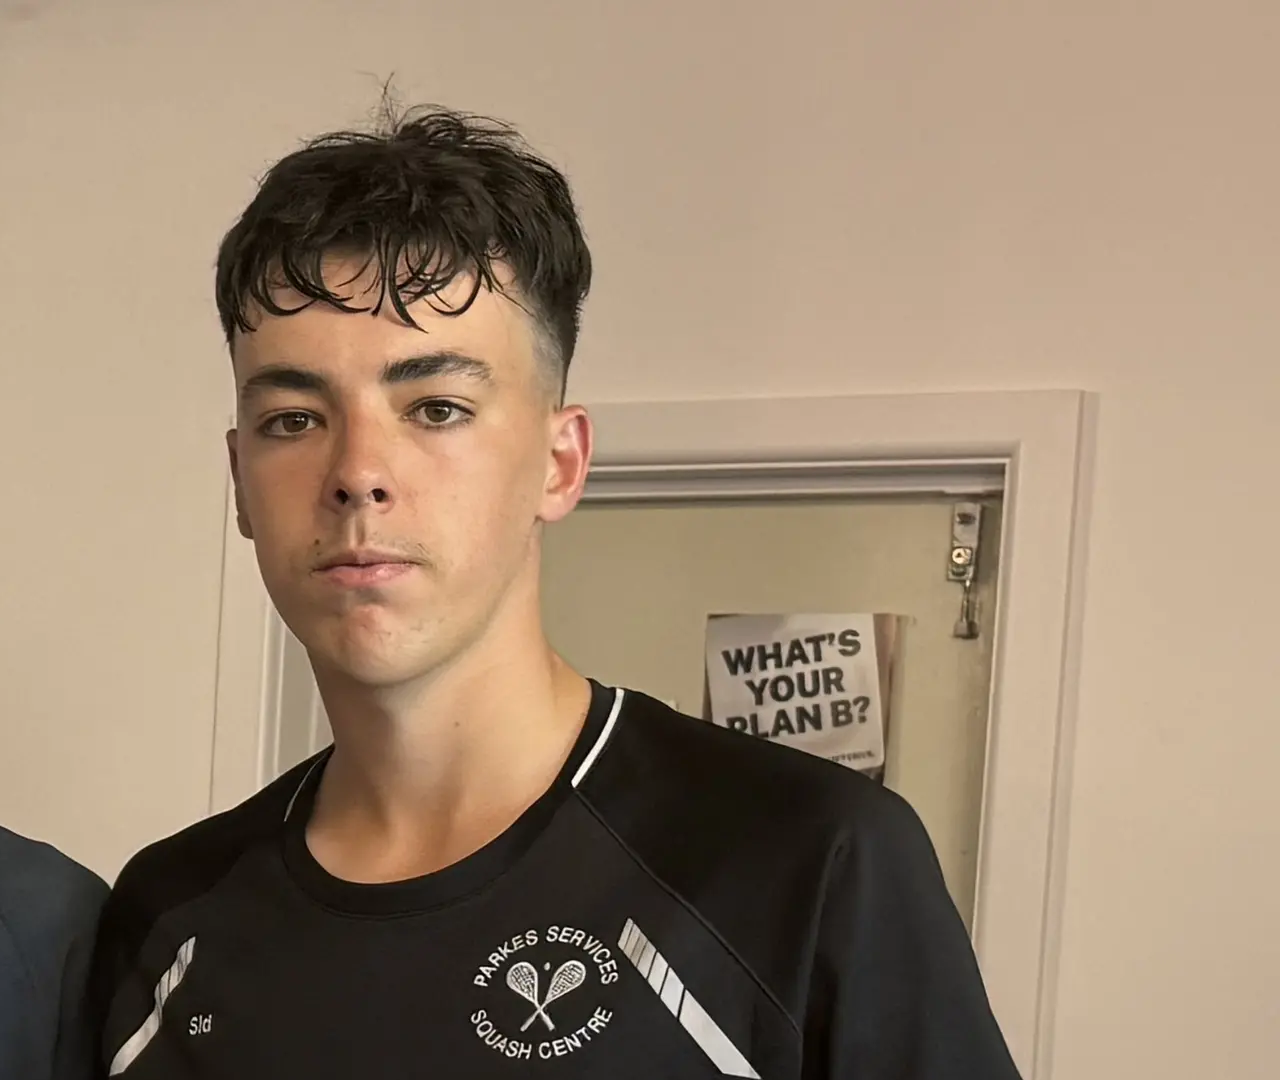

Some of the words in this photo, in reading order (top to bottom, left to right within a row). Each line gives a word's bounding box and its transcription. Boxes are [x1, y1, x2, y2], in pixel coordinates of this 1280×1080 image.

[721, 629, 862, 676] WHAT'S
[744, 667, 846, 706] YOUR
[830, 696, 871, 728] B?
[474, 930, 538, 987] PARKES
[546, 926, 619, 985] SERVICES
[471, 1009, 532, 1060] SQUASH
[539, 1006, 613, 1060] CENTRE
